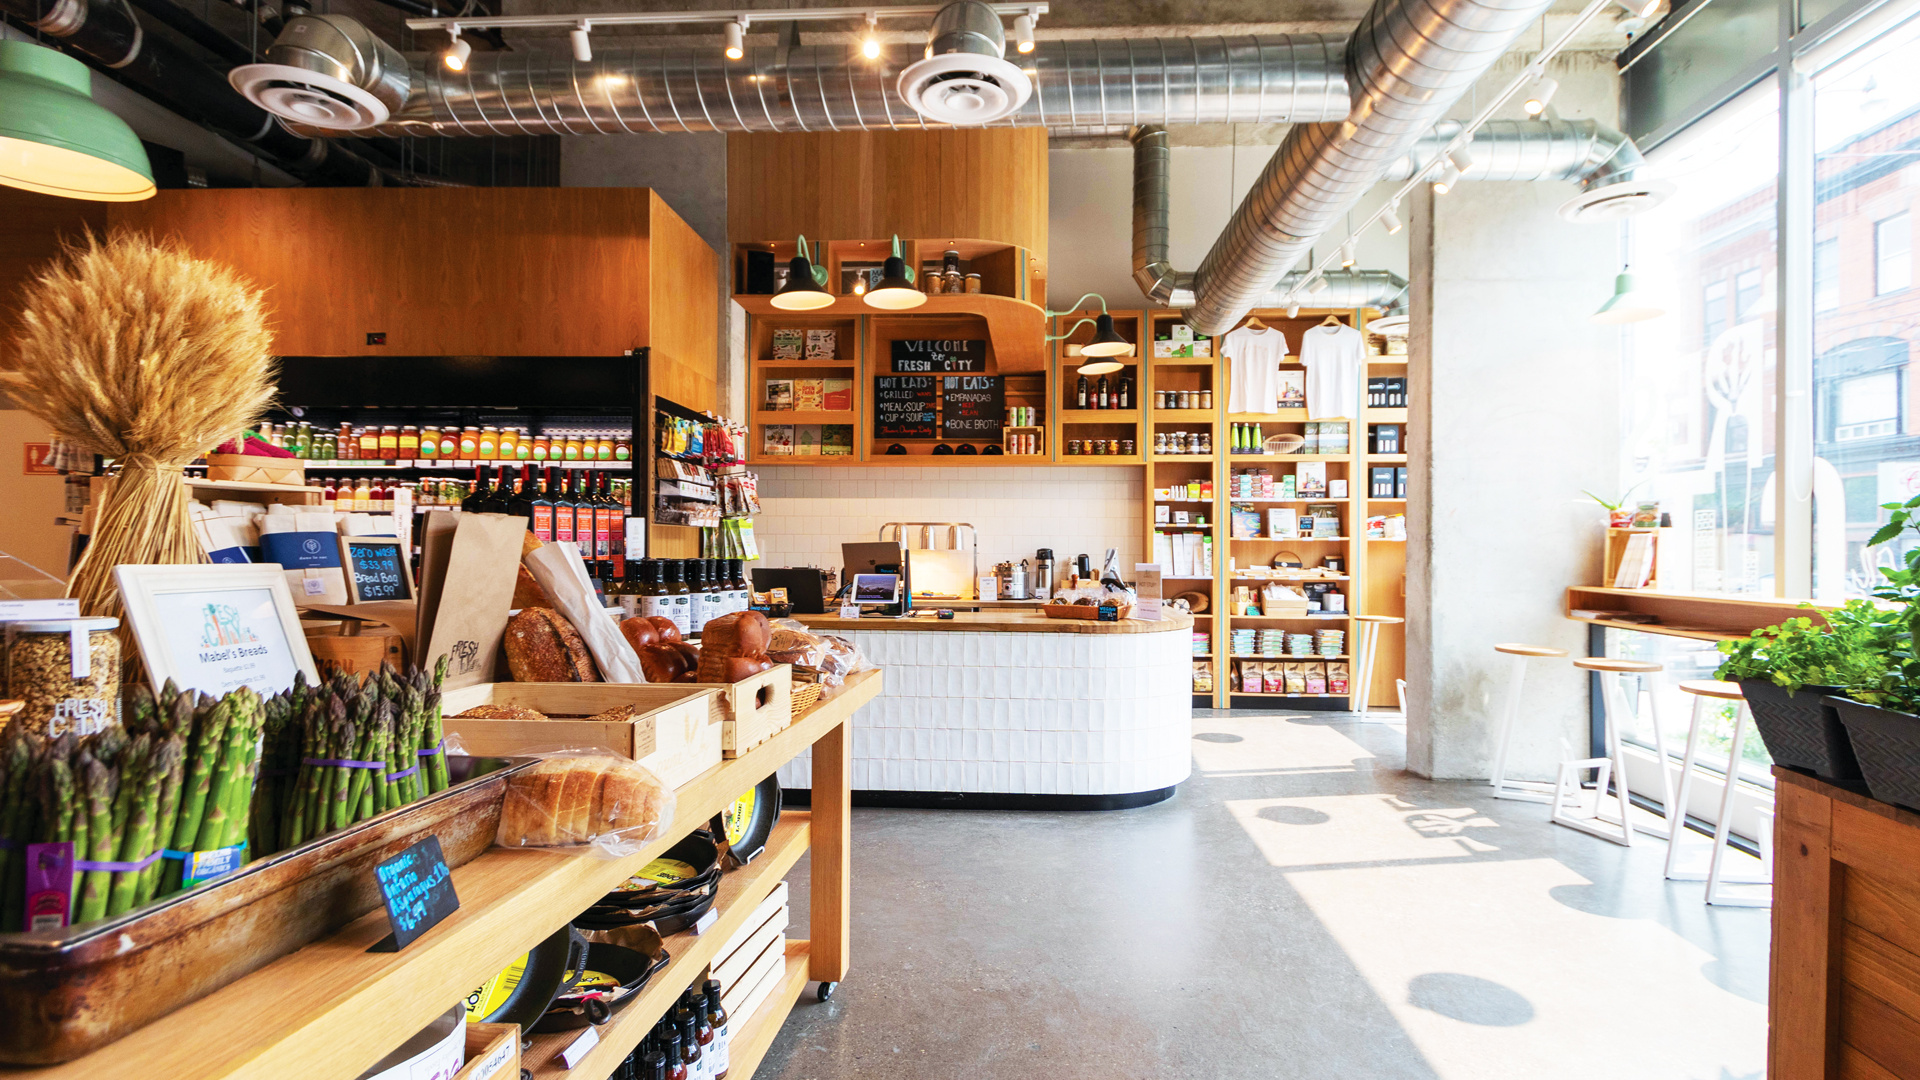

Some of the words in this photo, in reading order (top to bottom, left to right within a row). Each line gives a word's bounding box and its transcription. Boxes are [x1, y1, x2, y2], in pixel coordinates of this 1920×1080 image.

[904, 340, 968, 352] WELCOME
[898, 360, 931, 371] FRESH
[944, 358, 973, 371] CITY
[879, 377, 897, 388] HOT
[901, 377, 931, 388] EATS:
[944, 376, 959, 389] HOT
[963, 376, 994, 390] EATS:
[884, 391, 914, 399] GRILLED
[950, 393, 991, 402] EMPANADAS
[885, 413, 899, 422] CUP
[905, 412, 924, 422] SOUP
[950, 419, 972, 429] BONE
[974, 419, 999, 429] BROTH
[350, 547, 373, 558] Zero
[359, 560, 394, 571] $33.99
[354, 572, 380, 583] Bread
[380, 572, 399, 587] Bag
[364, 585, 395, 597] $15.99
[199, 649, 237, 663] Mabel's
[238, 645, 268, 658] Breads
[55, 698, 108, 718] FRESH
[378, 854, 414, 884] Organic
[389, 874, 437, 917] Asparagus
